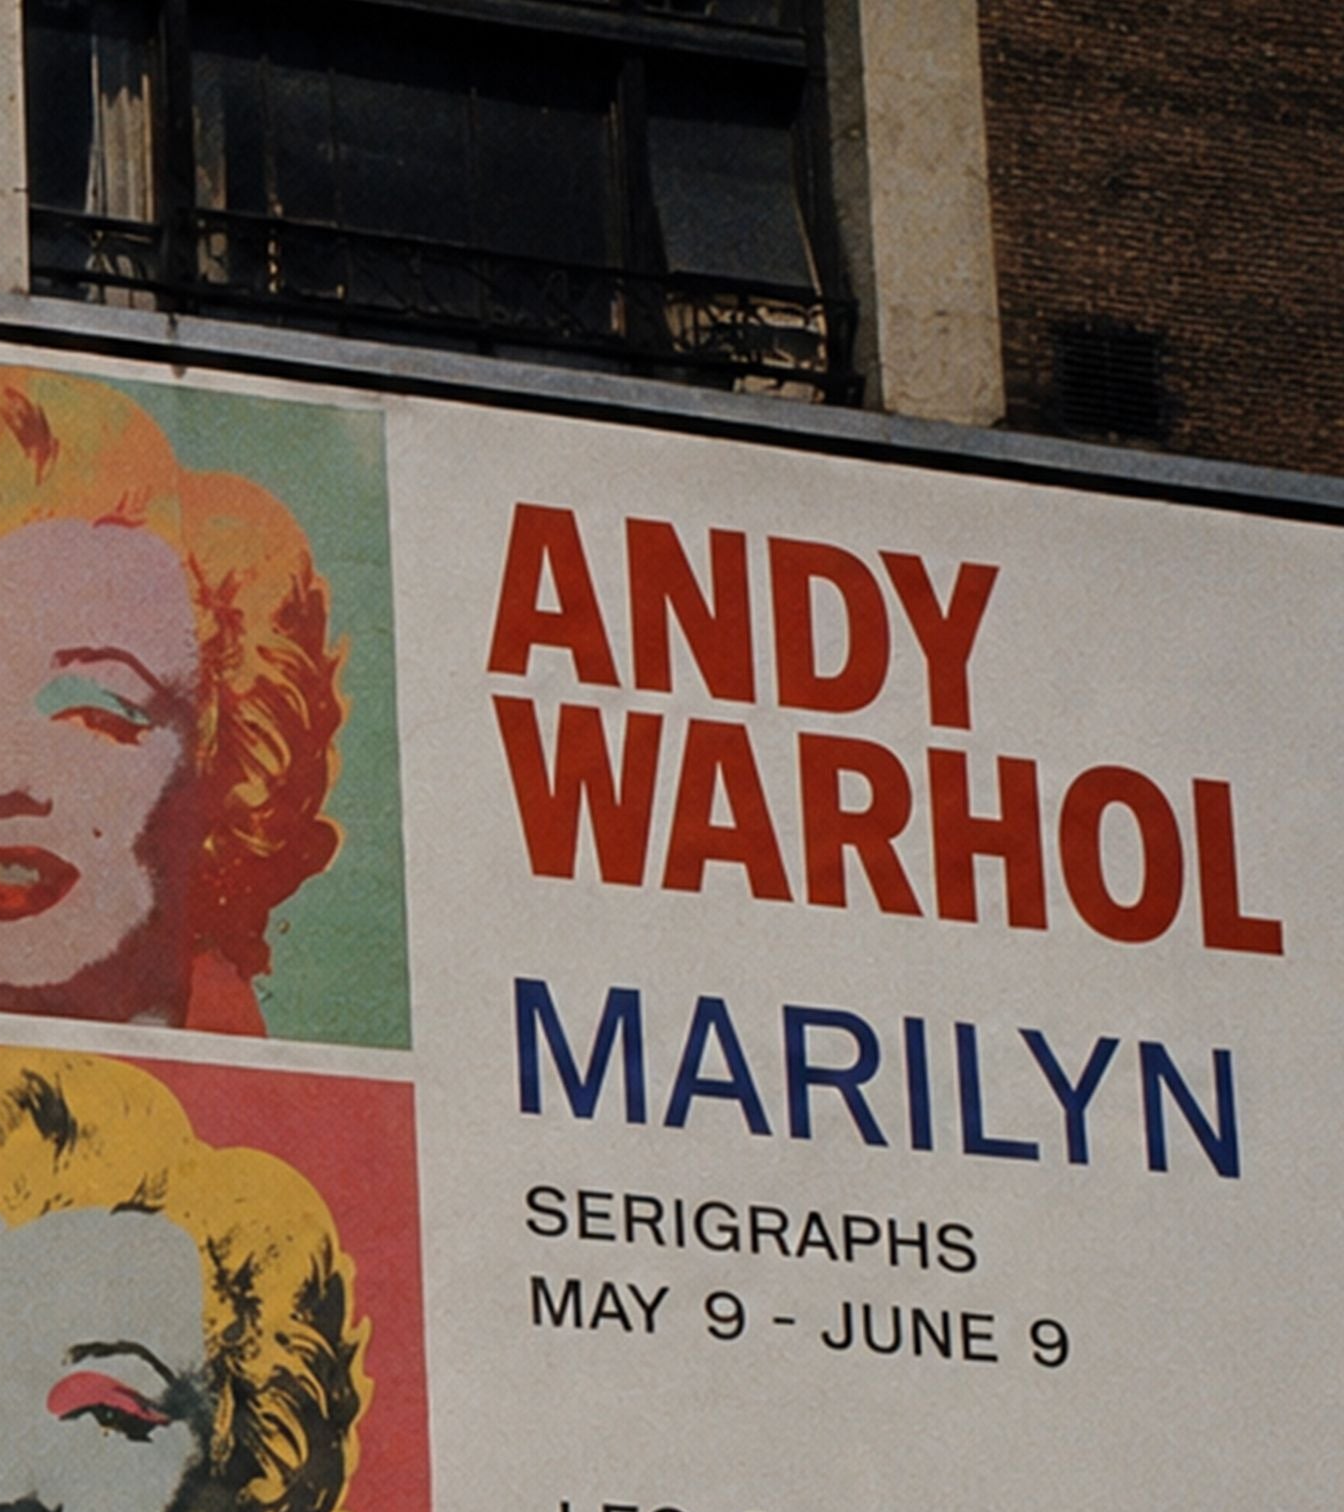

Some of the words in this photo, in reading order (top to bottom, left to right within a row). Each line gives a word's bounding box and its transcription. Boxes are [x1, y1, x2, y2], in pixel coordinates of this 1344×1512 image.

[487, 502, 1001, 731] ANDY
[490, 694, 1285, 956] WARHOL
[513, 976, 1241, 1179] MARILYN
[524, 1185, 979, 1273] SERIGRAPHS
[529, 1275, 670, 1334] MAY
[703, 1291, 747, 1340] 9
[772, 1315, 797, 1325] -
[821, 1302, 999, 1362] JUNE
[1029, 1318, 1071, 1368] 9
